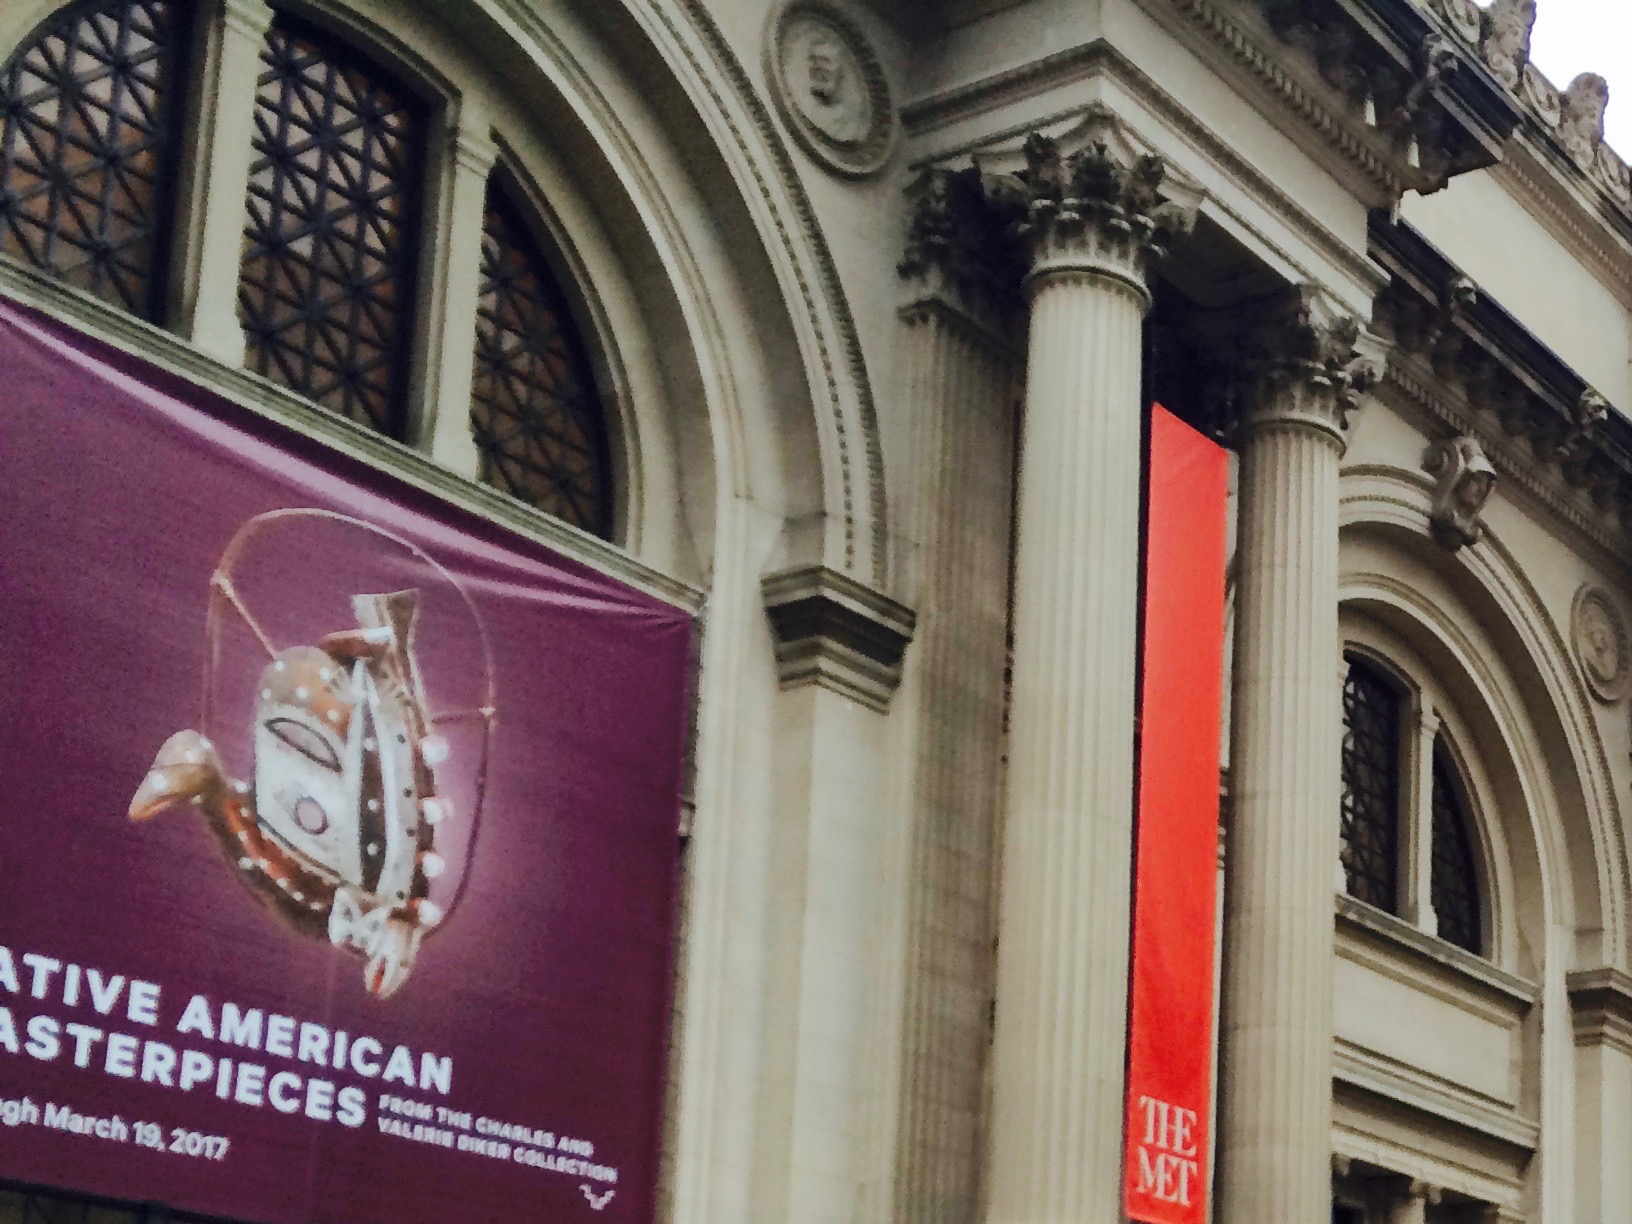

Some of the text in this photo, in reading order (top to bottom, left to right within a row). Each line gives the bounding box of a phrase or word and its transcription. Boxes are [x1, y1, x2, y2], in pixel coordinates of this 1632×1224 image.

[176, 994, 453, 1095] AMERICAN
[0, 1096, 231, 1161] gh March 19, 2017
[378, 1094, 594, 1159] FROM THE CHARLES AND
[1138, 1094, 1197, 1156] THE
[513, 1146, 619, 1184] COLLECTION
[1136, 1145, 1198, 1208] MET
